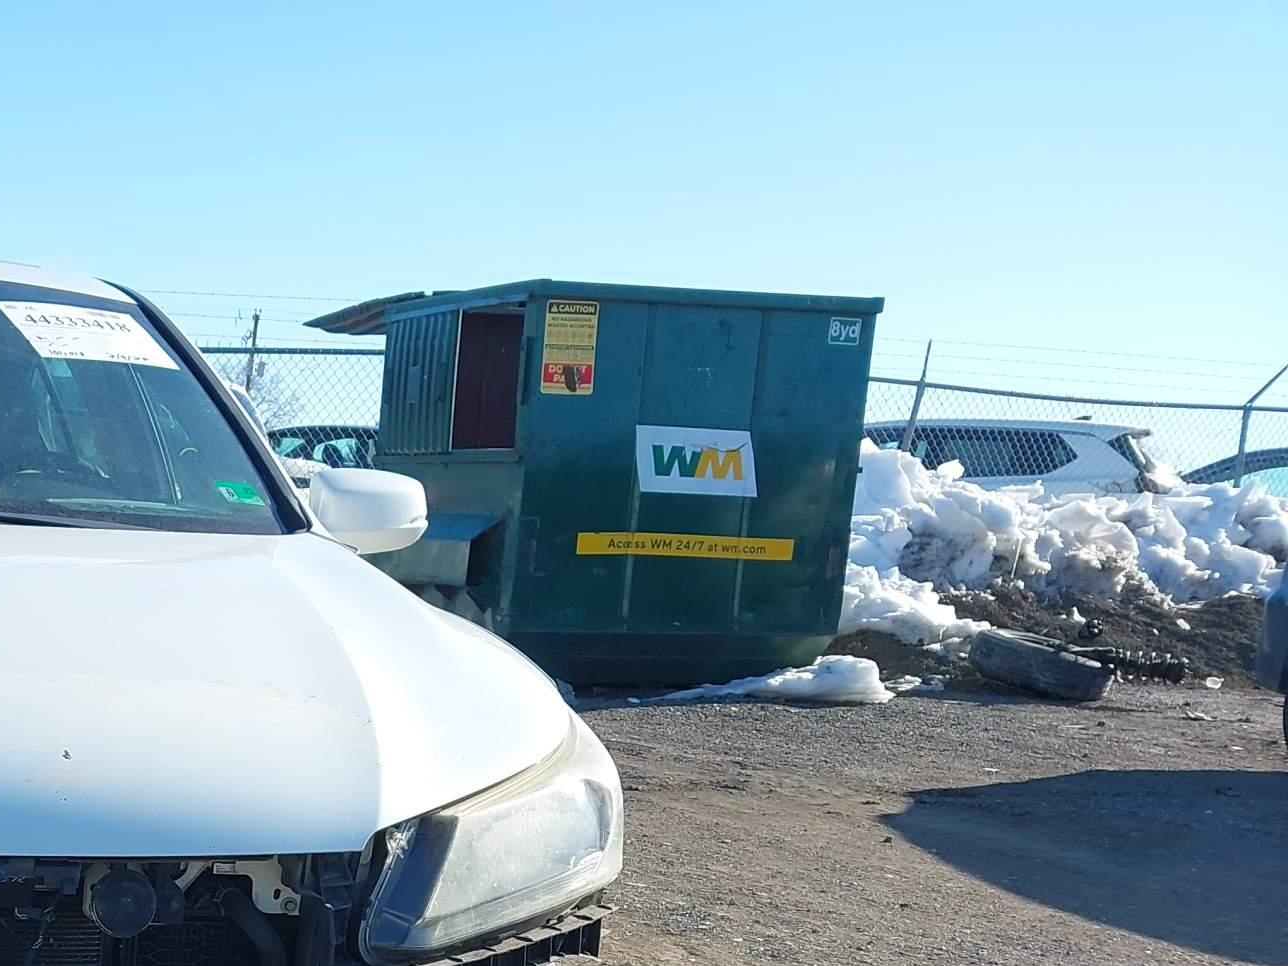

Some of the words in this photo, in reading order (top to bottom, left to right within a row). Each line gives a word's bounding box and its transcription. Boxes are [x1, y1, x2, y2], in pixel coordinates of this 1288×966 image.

[558, 304, 596, 313] CAUTION
[24, 313, 131, 333] 44333418
[831, 321, 861, 341] 8yd
[548, 364, 563, 374] DO
[651, 444, 744, 481] WM
[607, 538, 647, 550] Access
[650, 539, 672, 550] WM
[675, 539, 704, 552] 24/7
[707, 543, 718, 552] at
